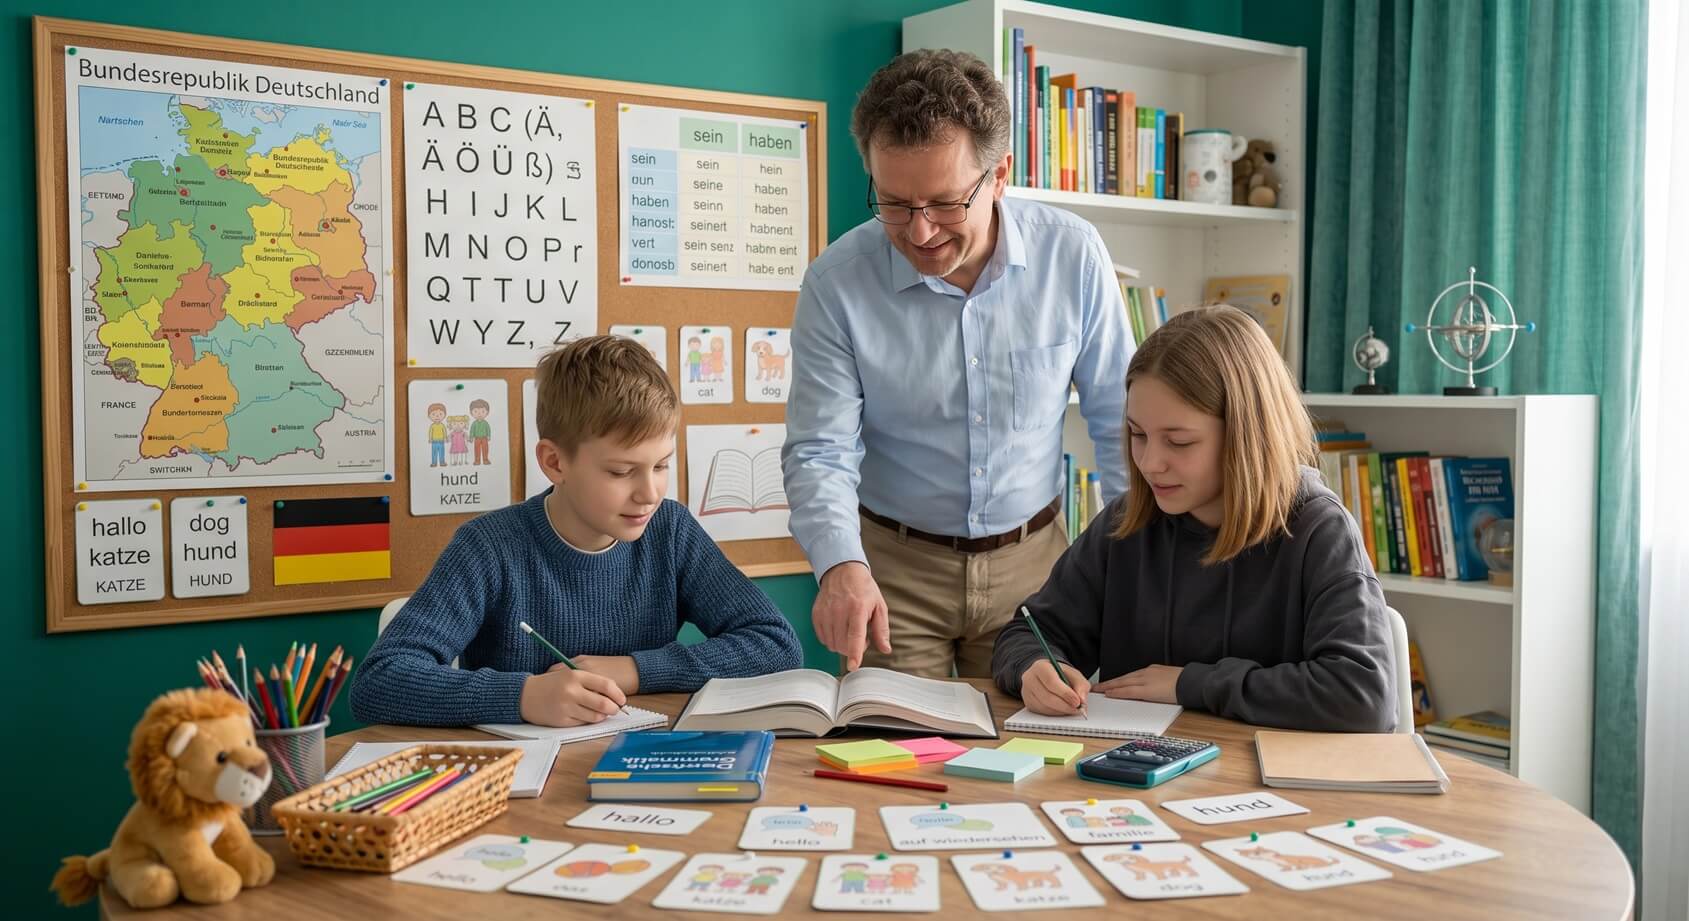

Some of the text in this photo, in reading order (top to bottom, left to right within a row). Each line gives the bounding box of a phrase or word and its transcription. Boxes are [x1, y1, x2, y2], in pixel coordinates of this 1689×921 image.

[79, 58, 379, 104] Bundesrepublik Deutschland
[423, 101, 445, 127] A
[458, 104, 477, 129] B
[491, 107, 511, 132] C
[694, 129, 792, 150] sein haben
[273, 154, 329, 164] Bundesrepublik
[422, 139, 444, 171] Ä
[456, 142, 479, 173] Ö
[493, 145, 512, 175] Ü
[631, 153, 782, 175] sein sein hein
[693, 180, 723, 191] seine
[754, 184, 788, 196] haben
[427, 188, 447, 215] H
[494, 193, 507, 218] J
[527, 194, 545, 220] K
[562, 197, 577, 221] L
[632, 194, 788, 215] haben seinn haben
[690, 221, 727, 232] seinert
[425, 232, 449, 258] M
[468, 234, 488, 260] N
[505, 236, 527, 261] O
[632, 238, 655, 249] vert
[684, 240, 707, 251] sein
[632, 258, 794, 275] donosb seinert habe ent
[427, 276, 578, 304] Q T T U V
[429, 319, 460, 345] W
[473, 320, 493, 344] Y
[507, 321, 533, 349] Z,
[698, 388, 714, 397] cat
[762, 386, 781, 397] dog
[440, 472, 478, 486] hund
[440, 493, 481, 505] KATZE
[92, 516, 146, 537] hallo
[189, 514, 229, 535] dog
[90, 547, 151, 567] katze
[184, 541, 237, 561] hund
[96, 579, 146, 593] KATZE
[190, 573, 233, 587] HUND
[1193, 799, 1272, 815] hund
[602, 811, 676, 827] hallo
